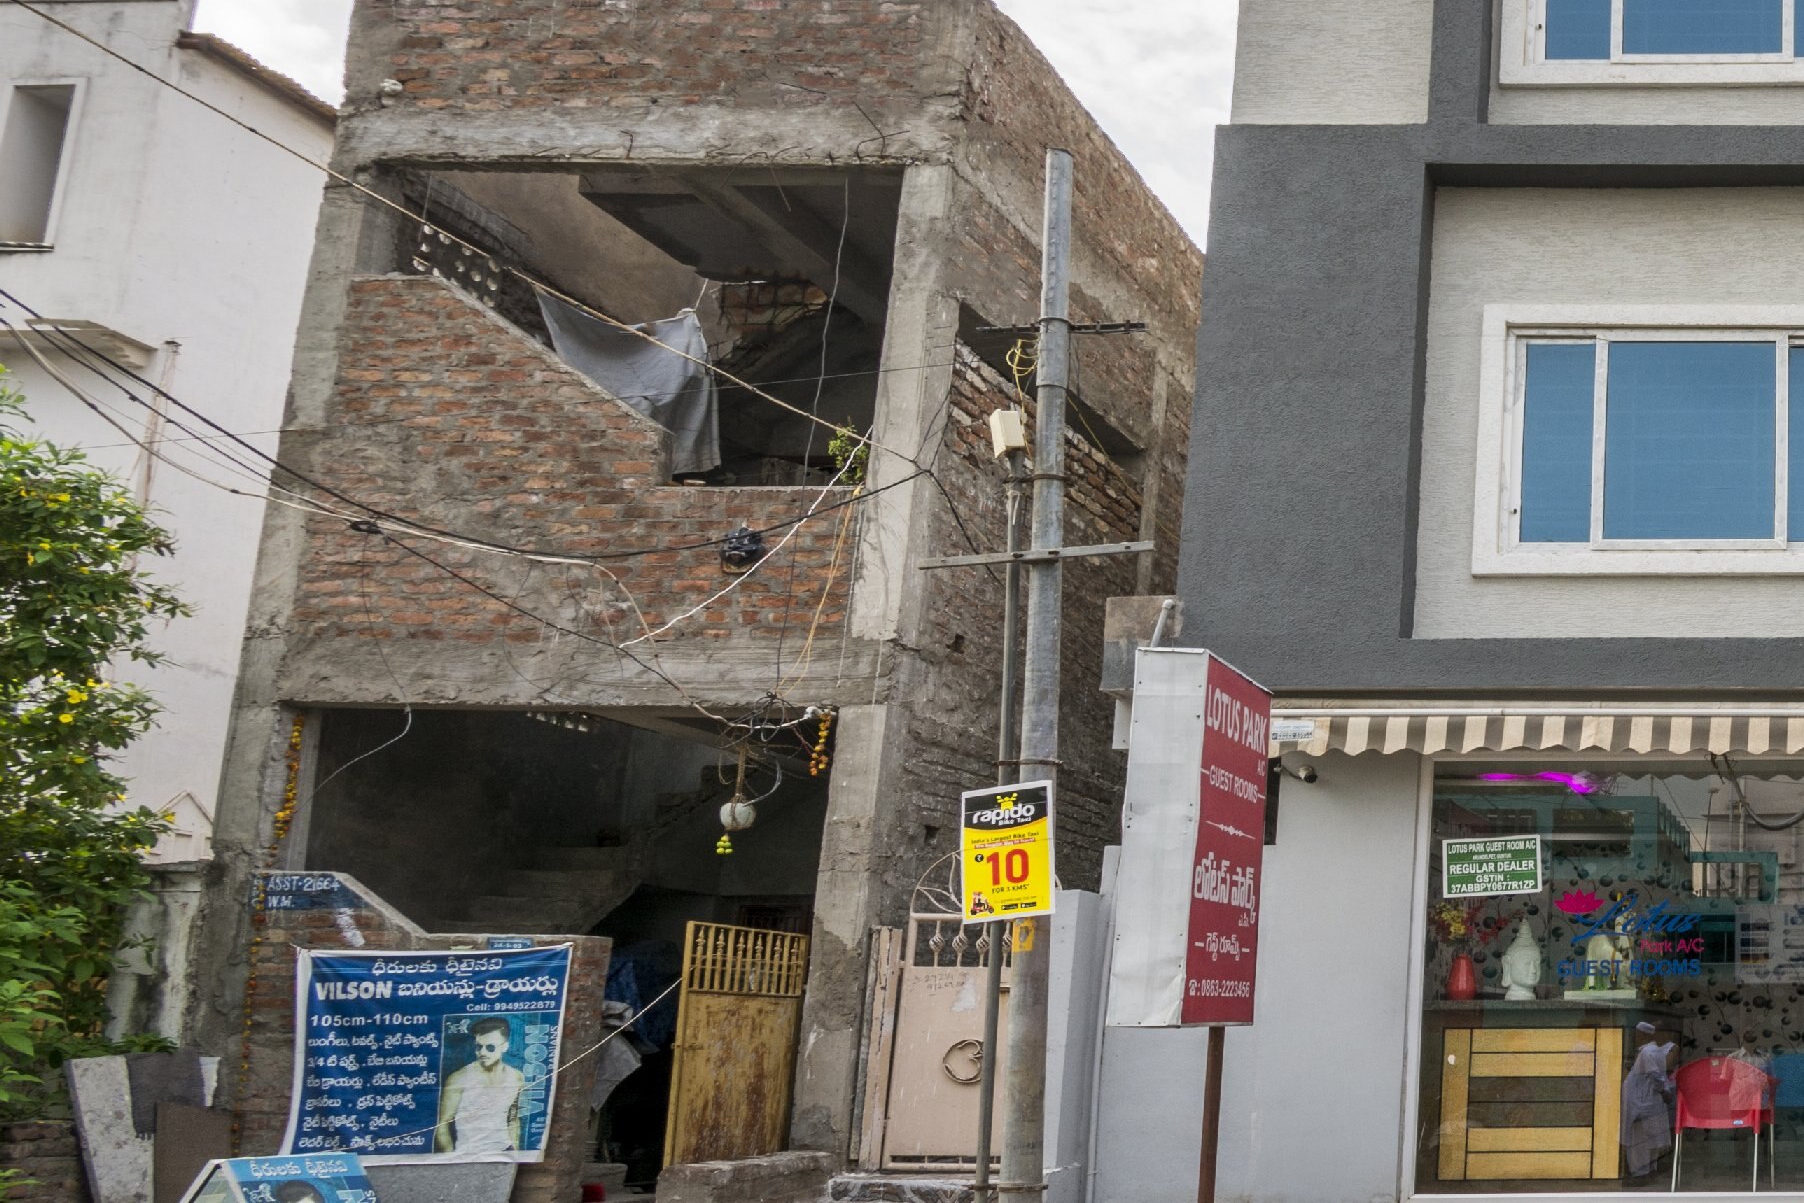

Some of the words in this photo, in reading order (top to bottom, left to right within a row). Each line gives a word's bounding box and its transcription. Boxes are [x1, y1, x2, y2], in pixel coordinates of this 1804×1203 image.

[1207, 684, 1241, 742] LOTUS
[1241, 706, 1267, 755] PARK
[1208, 765, 1233, 792] GUEST
[1234, 776, 1258, 803] ROOMS
[973, 803, 1035, 825] rapido
[1448, 844, 1468, 854] LOTUS
[1468, 842, 1485, 853] PARK
[1485, 841, 1505, 852] GUEST
[1507, 840, 1525, 850] ROOM
[1525, 840, 1536, 849] A/C
[986, 848, 1029, 886] 10
[1449, 862, 1495, 875] REGULAR
[1497, 860, 1535, 871] DEALER
[1194, 852, 1230, 903] లోటస్
[1231, 866, 1256, 924] పార్క్
[1475, 874, 1504, 883] GSTIN
[1570, 893, 1705, 943] Lotus
[1640, 939, 1672, 953] Park
[1676, 937, 1705, 953] A/C
[1555, 960, 1623, 977] GUEST
[1629, 959, 1700, 975] ROOMS
[315, 980, 392, 1000] VILSON
[466, 1002, 491, 1012] Cell:
[310, 1013, 428, 1026] 105cm-110cm
[517, 1024, 549, 1117] VILSON
